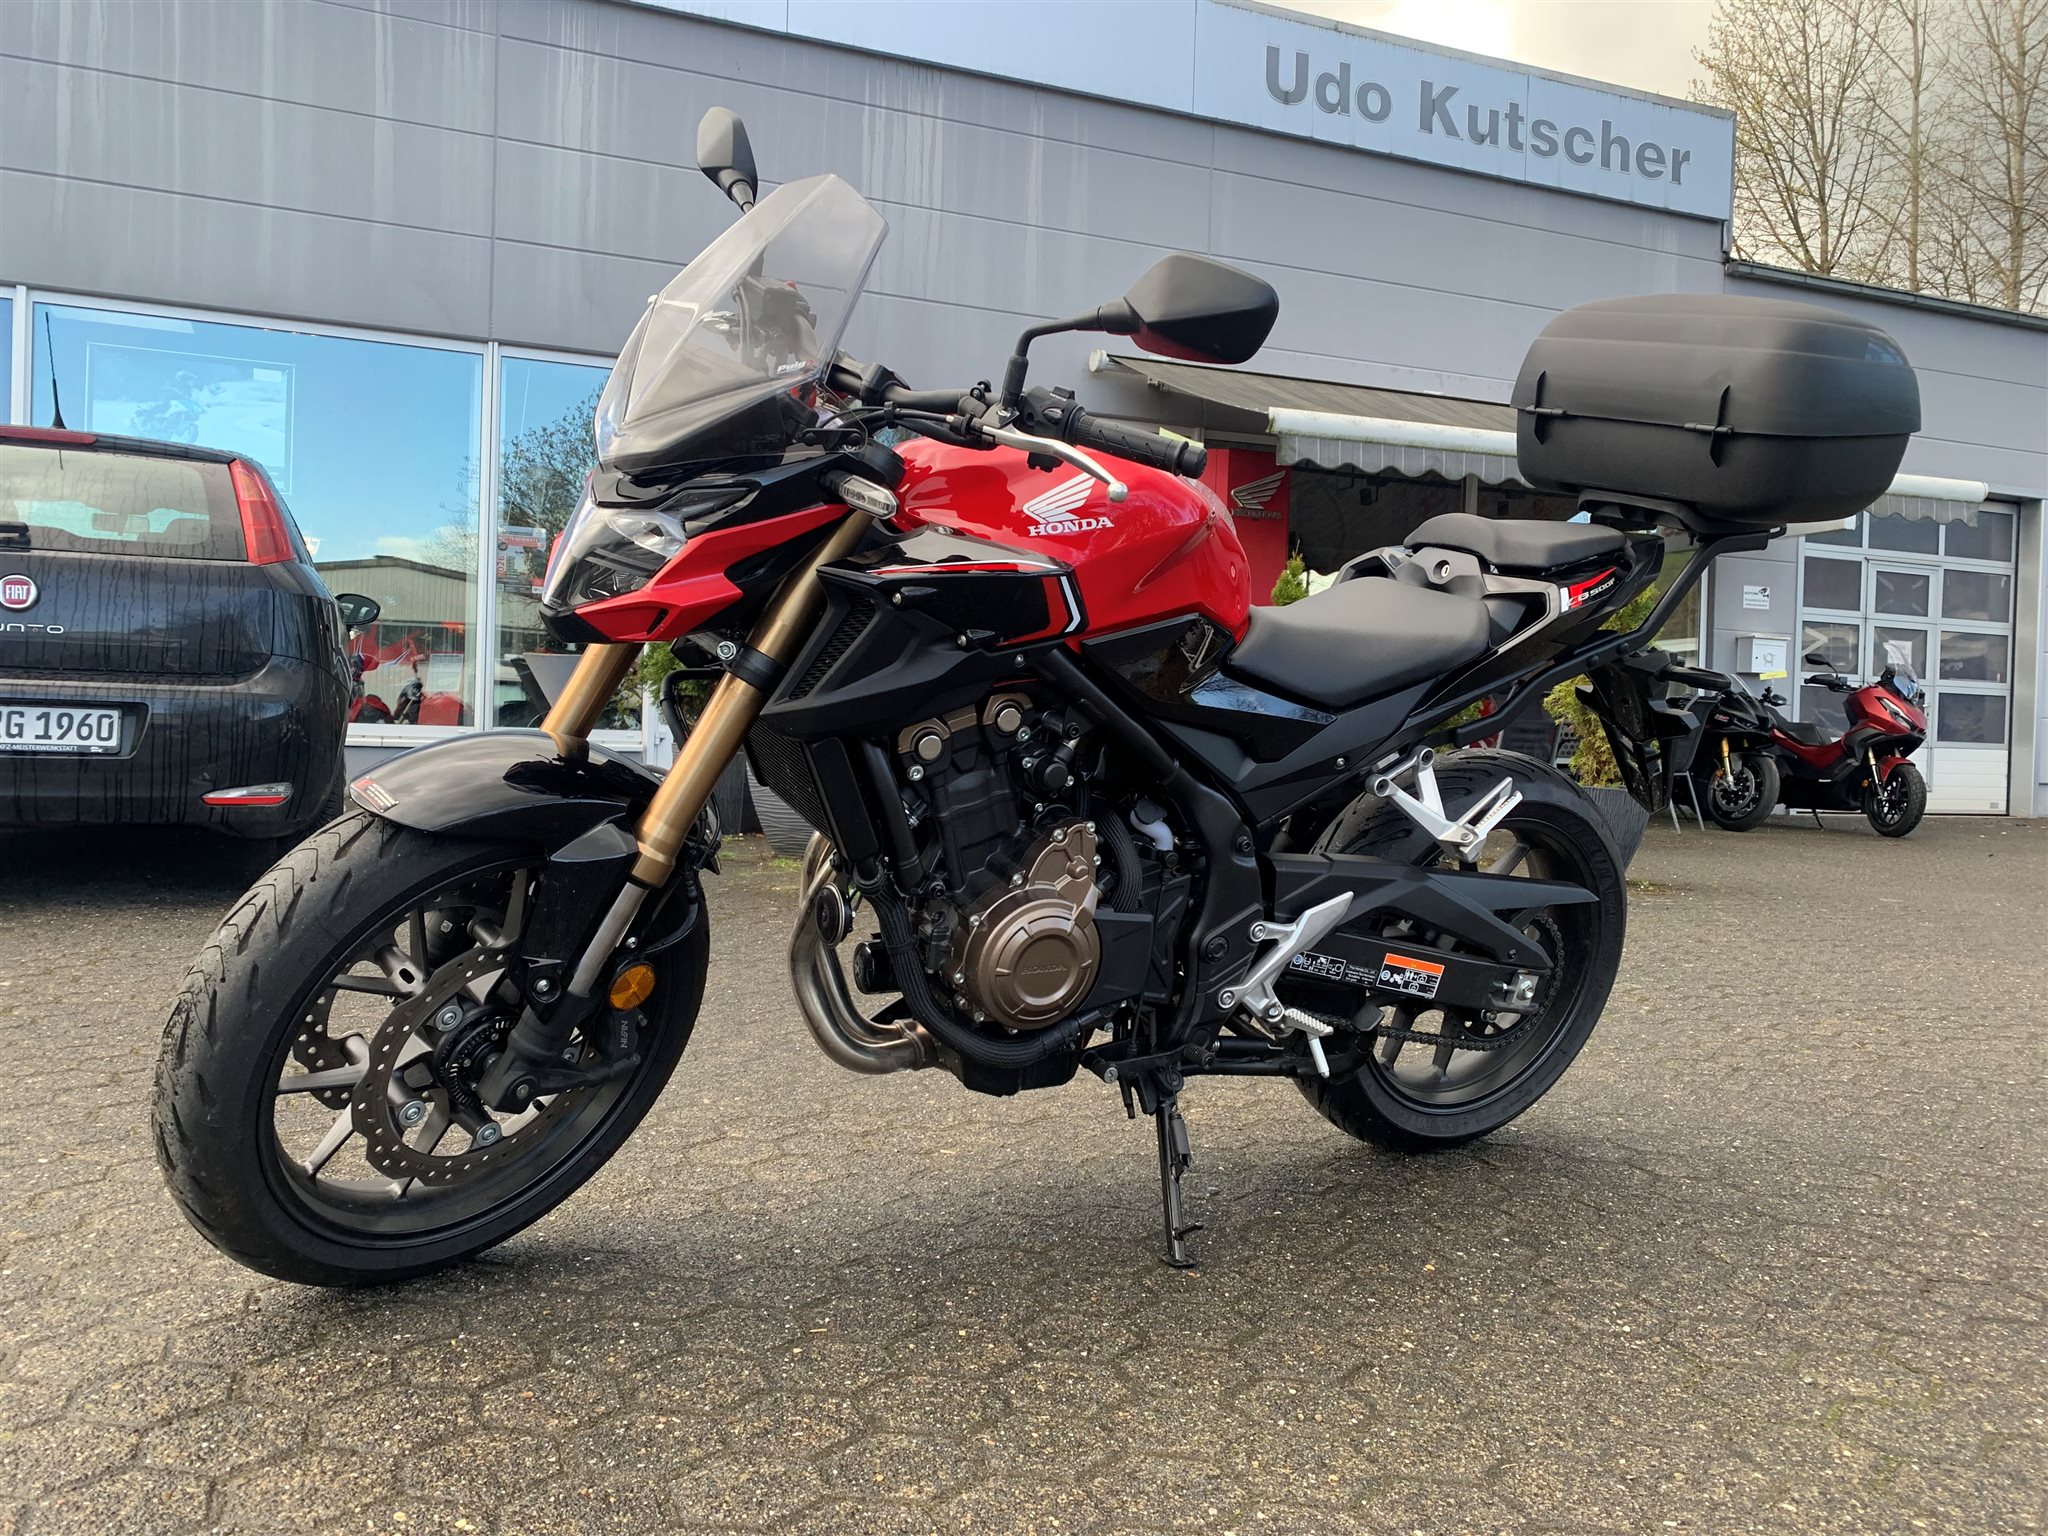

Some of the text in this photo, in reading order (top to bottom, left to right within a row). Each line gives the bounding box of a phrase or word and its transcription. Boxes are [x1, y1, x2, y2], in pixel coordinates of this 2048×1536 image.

[1266, 43, 1691, 185] Udo Kutscher
[1027, 517, 1115, 537] HONDA
[5, 585, 29, 600] FIAT
[0, 710, 115, 742] G 1960
